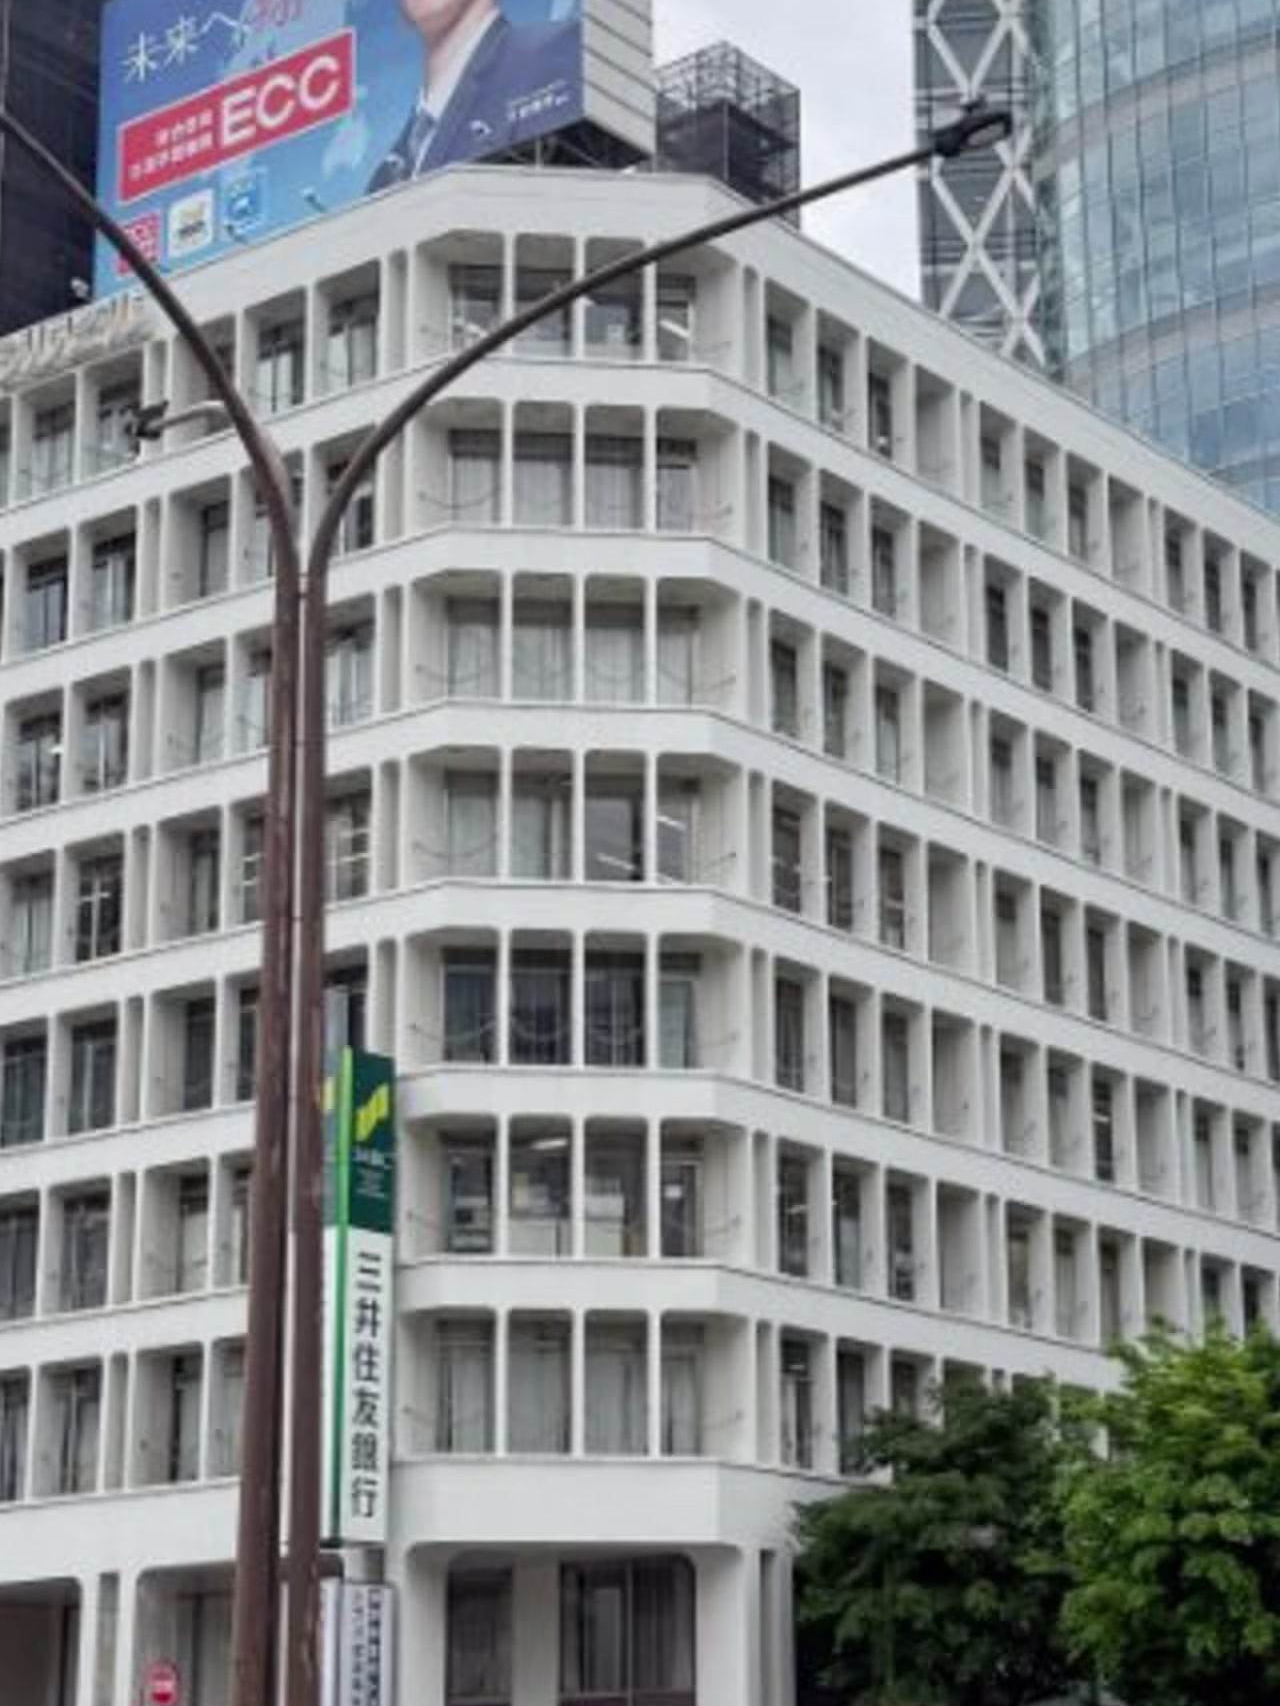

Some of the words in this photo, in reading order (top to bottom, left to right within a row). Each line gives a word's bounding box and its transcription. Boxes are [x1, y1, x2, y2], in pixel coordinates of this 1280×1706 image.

[222, 55, 340, 147] ECC
[351, 1250, 382, 1518] 三井住友銀行
